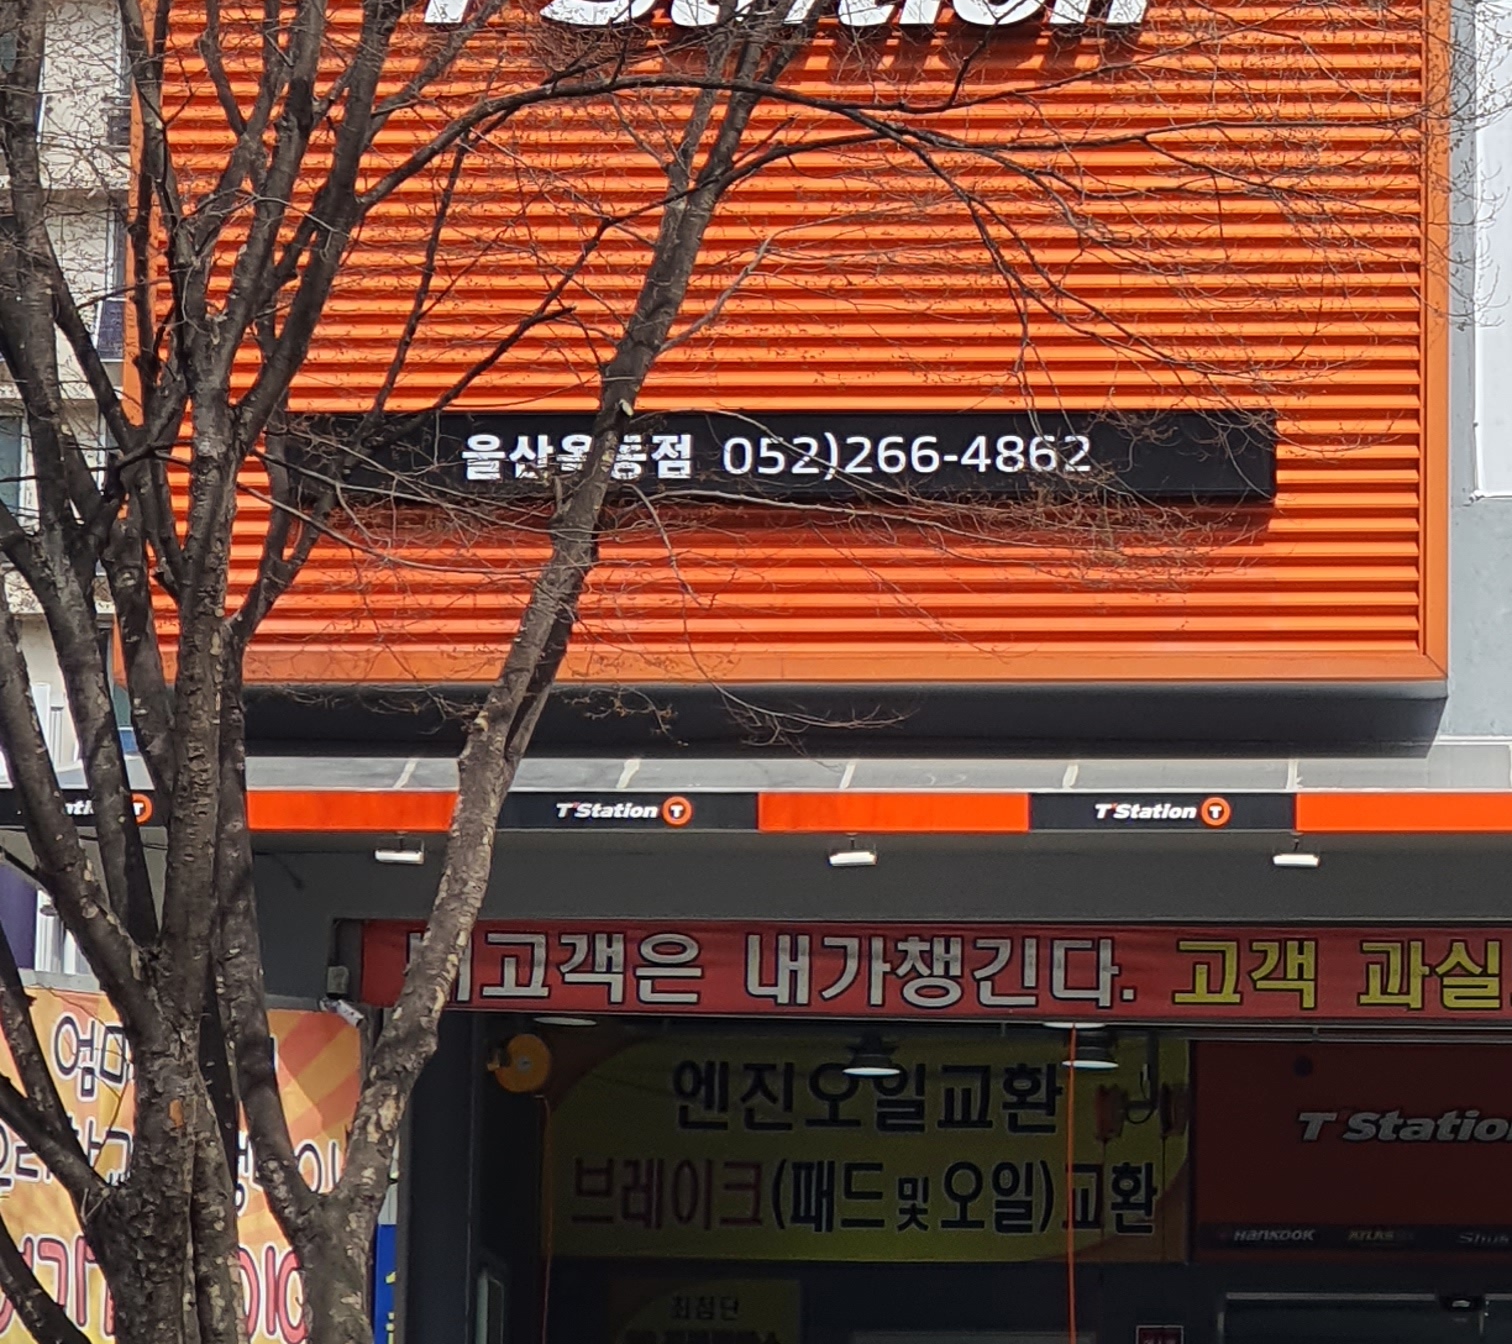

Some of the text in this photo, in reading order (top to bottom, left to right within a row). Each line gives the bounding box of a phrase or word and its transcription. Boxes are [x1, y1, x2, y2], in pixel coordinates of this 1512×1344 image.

[723, 433, 1092, 482] 052)266-4862
[745, 934, 1135, 1008] 내가챙긴다.
[1174, 941, 1316, 1010] 고객
[673, 1059, 1064, 1133] 엔진오일교환
